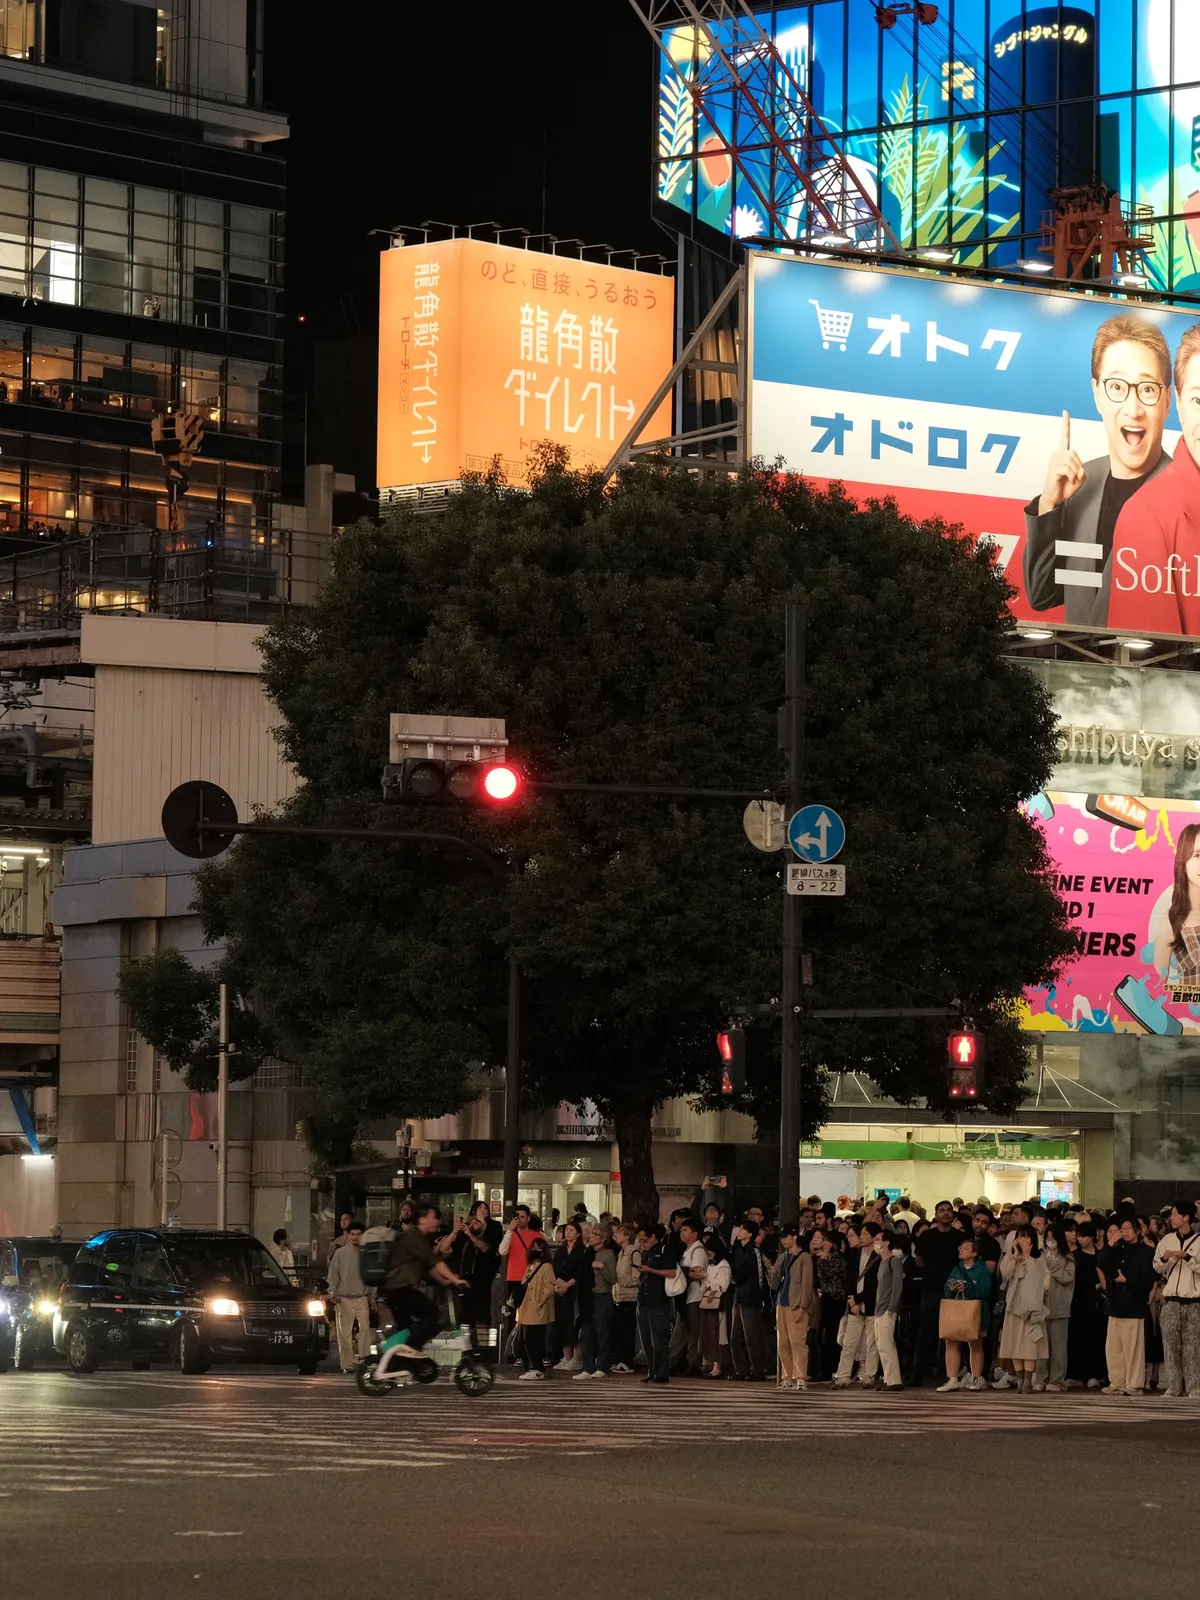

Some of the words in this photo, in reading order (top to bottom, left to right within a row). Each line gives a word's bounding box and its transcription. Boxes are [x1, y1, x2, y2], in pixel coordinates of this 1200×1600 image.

[481, 260, 657, 310] のど、直接、うるおう
[520, 303, 619, 375] 龍角散
[867, 313, 1022, 371] オトク
[411, 261, 441, 464] 龍角散ダイレクト
[504, 369, 635, 440] ダイレクト
[810, 412, 1021, 475] オドロク
[1055, 723, 1178, 761] shibuya
[1103, 795, 1128, 815] ON
[1127, 803, 1147, 824] AIR
[792, 868, 843, 879] 路線バスを除く
[821, 882, 836, 892] 22
[1090, 876, 1153, 894] EVENT
[1088, 902, 1095, 918] 1
[562, 1126, 597, 1134] SHIBUYA
